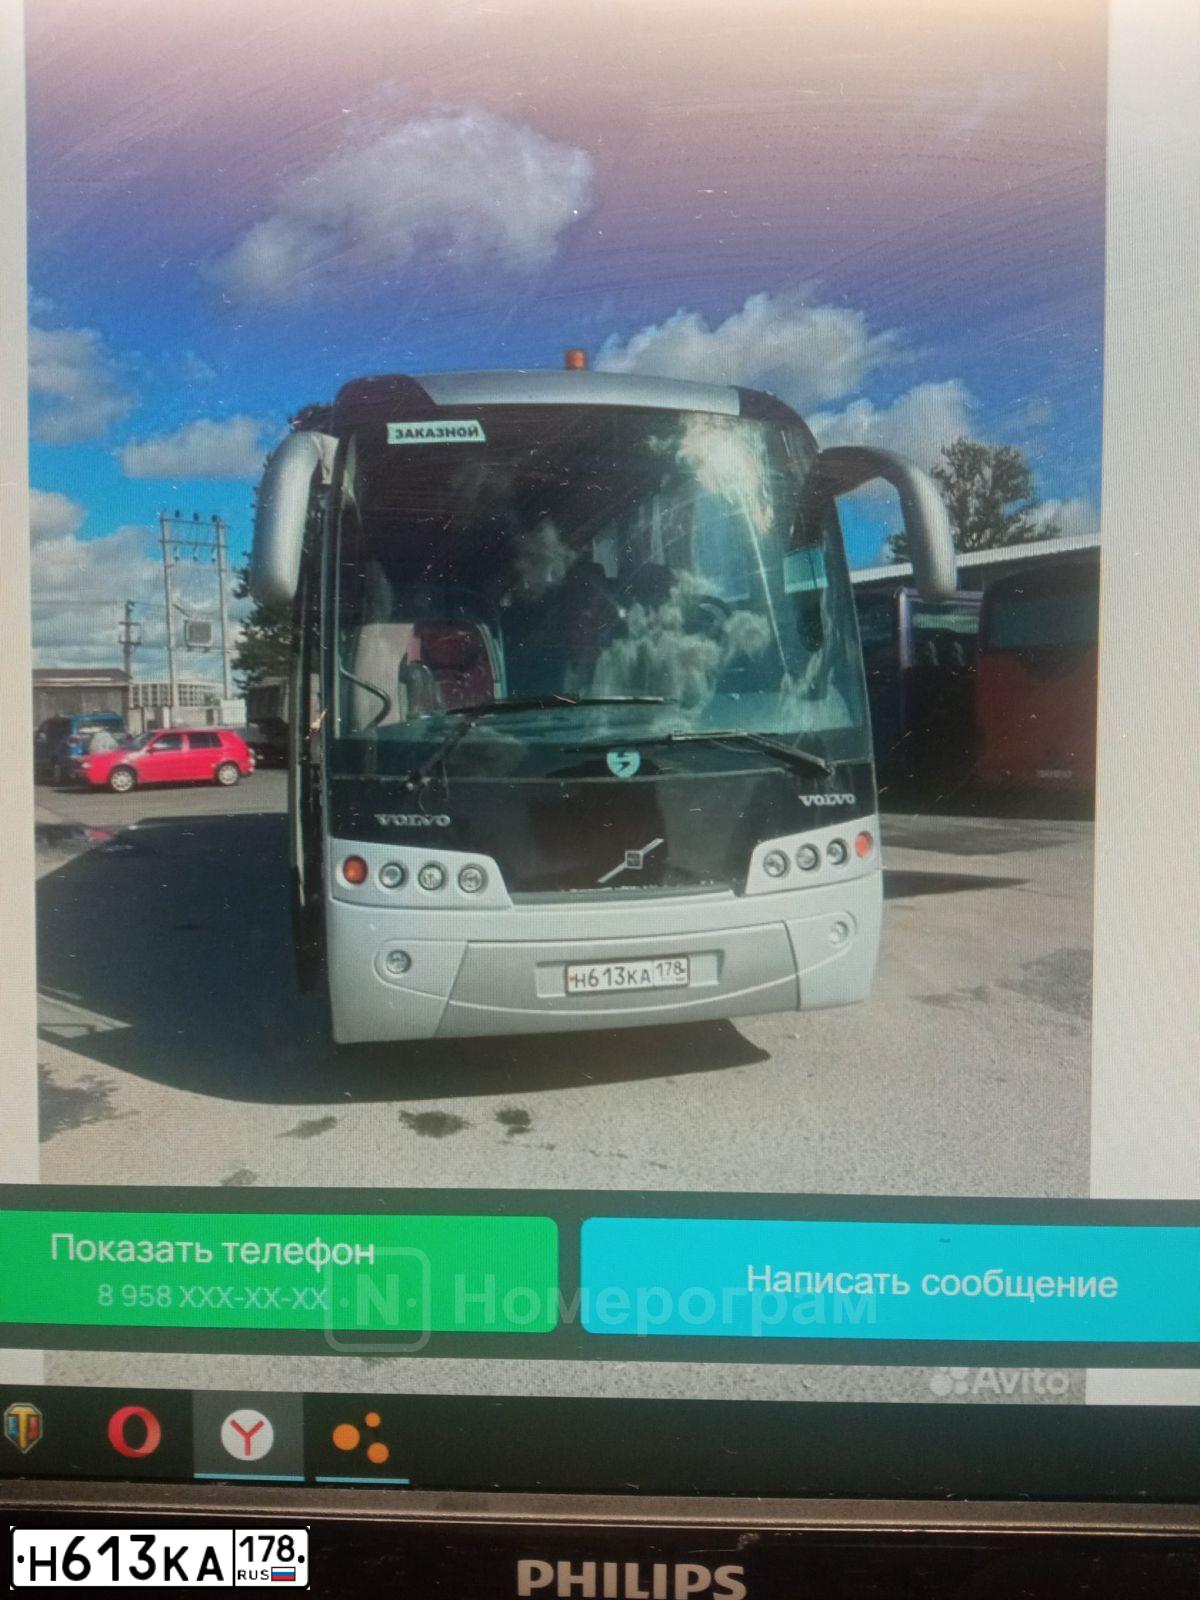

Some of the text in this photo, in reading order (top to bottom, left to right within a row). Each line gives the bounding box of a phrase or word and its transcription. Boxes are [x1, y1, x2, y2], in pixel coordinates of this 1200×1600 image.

[394, 425, 480, 440] ЗАКАЗНОЙ
[798, 793, 856, 807] VOLVO
[373, 814, 451, 827] VOLVO
[51, 1233, 376, 1274] Показать телефон
[98, 1284, 114, 1307] 8
[121, 1284, 172, 1308] 958
[746, 1263, 1120, 1303] Написать сообщение
[971, 1367, 1070, 1396] Avito
[517, 1558, 748, 1600] PHILIPS
